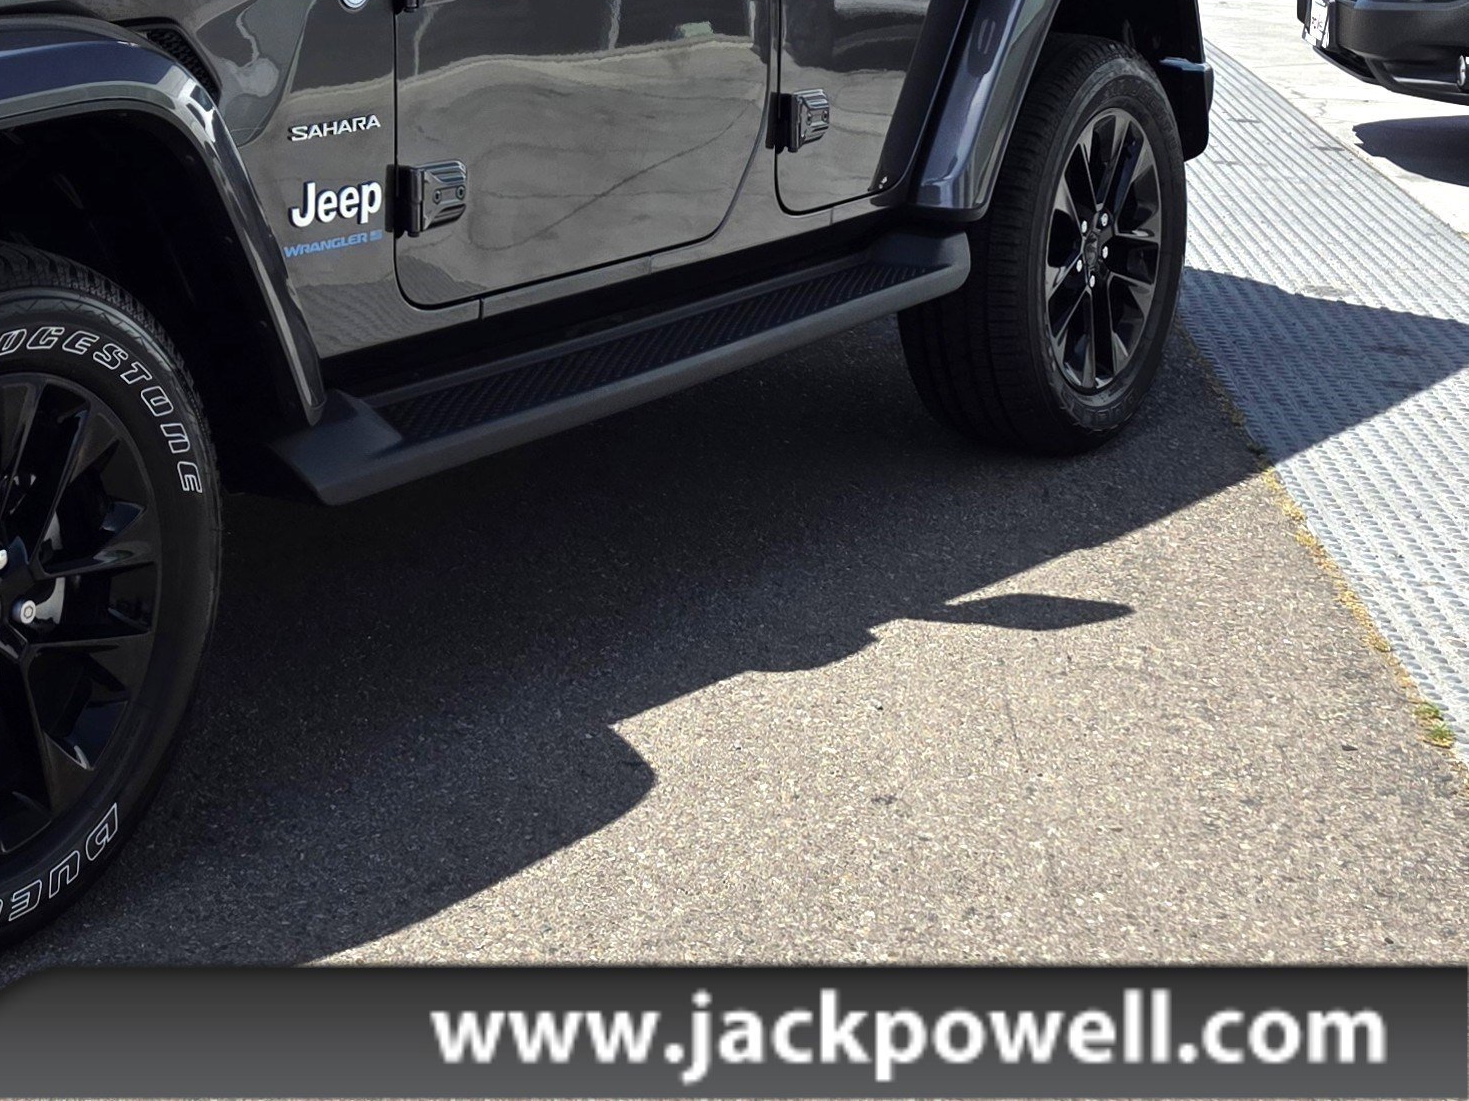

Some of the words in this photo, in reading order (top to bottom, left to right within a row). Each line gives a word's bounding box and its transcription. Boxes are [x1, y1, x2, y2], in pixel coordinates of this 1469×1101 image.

[290, 114, 382, 142] SAHARA
[289, 180, 383, 228] Jeep
[283, 231, 368, 259] WRANGLER
